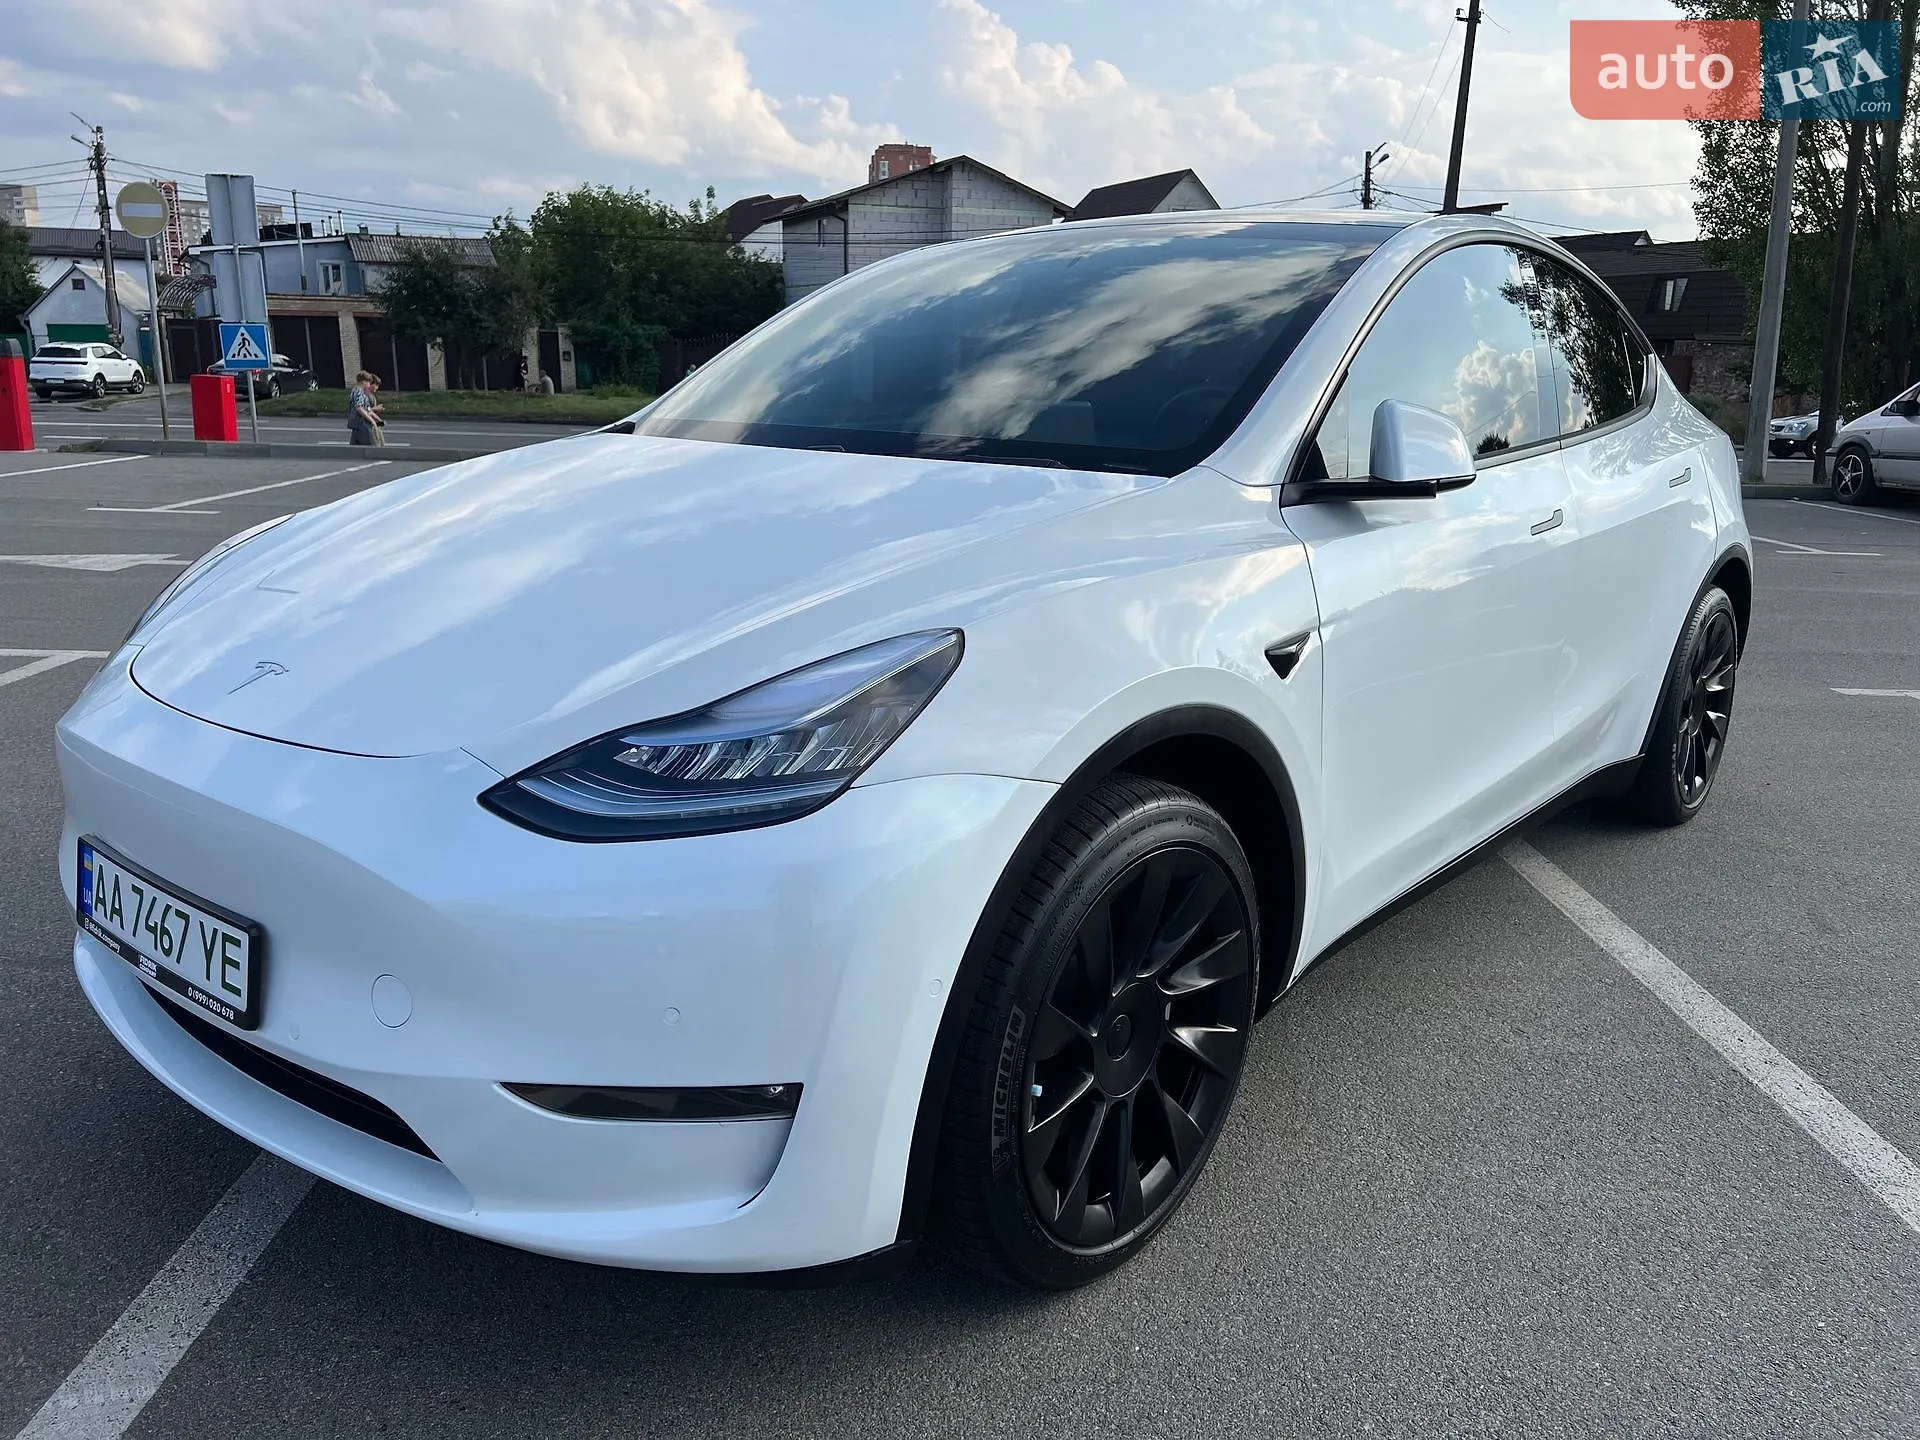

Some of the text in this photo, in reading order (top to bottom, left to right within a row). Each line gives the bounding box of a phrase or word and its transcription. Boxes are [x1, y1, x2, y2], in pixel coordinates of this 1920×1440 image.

[94, 863, 242, 998] AA 7467 YE
[221, 1006, 234, 1020] 678
[993, 1010, 1023, 1138] MICHELIN
